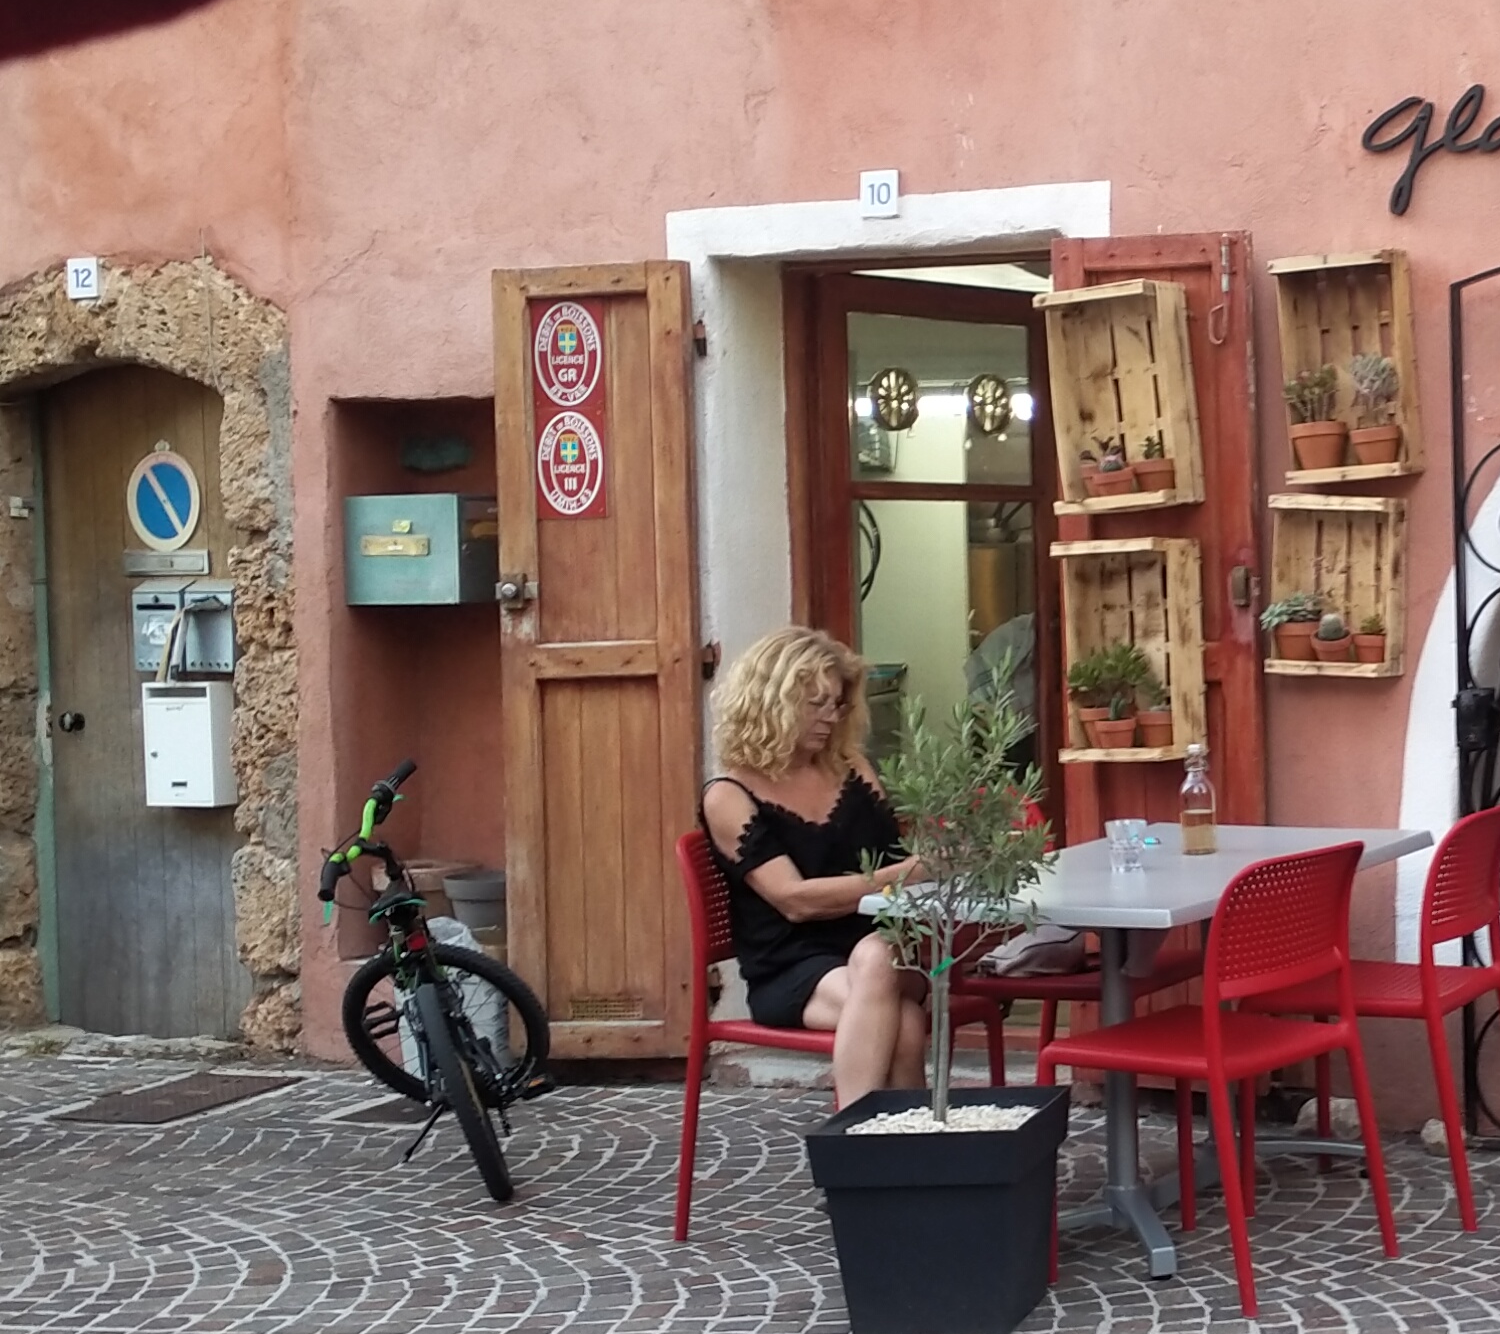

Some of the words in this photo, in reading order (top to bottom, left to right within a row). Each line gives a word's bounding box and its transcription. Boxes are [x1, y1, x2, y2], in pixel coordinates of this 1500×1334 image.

[867, 182, 891, 205] 10
[72, 267, 93, 289] 12
[551, 354, 585, 365] LICENCE
[557, 368, 578, 383] GR
[554, 464, 586, 474] LICENCE
